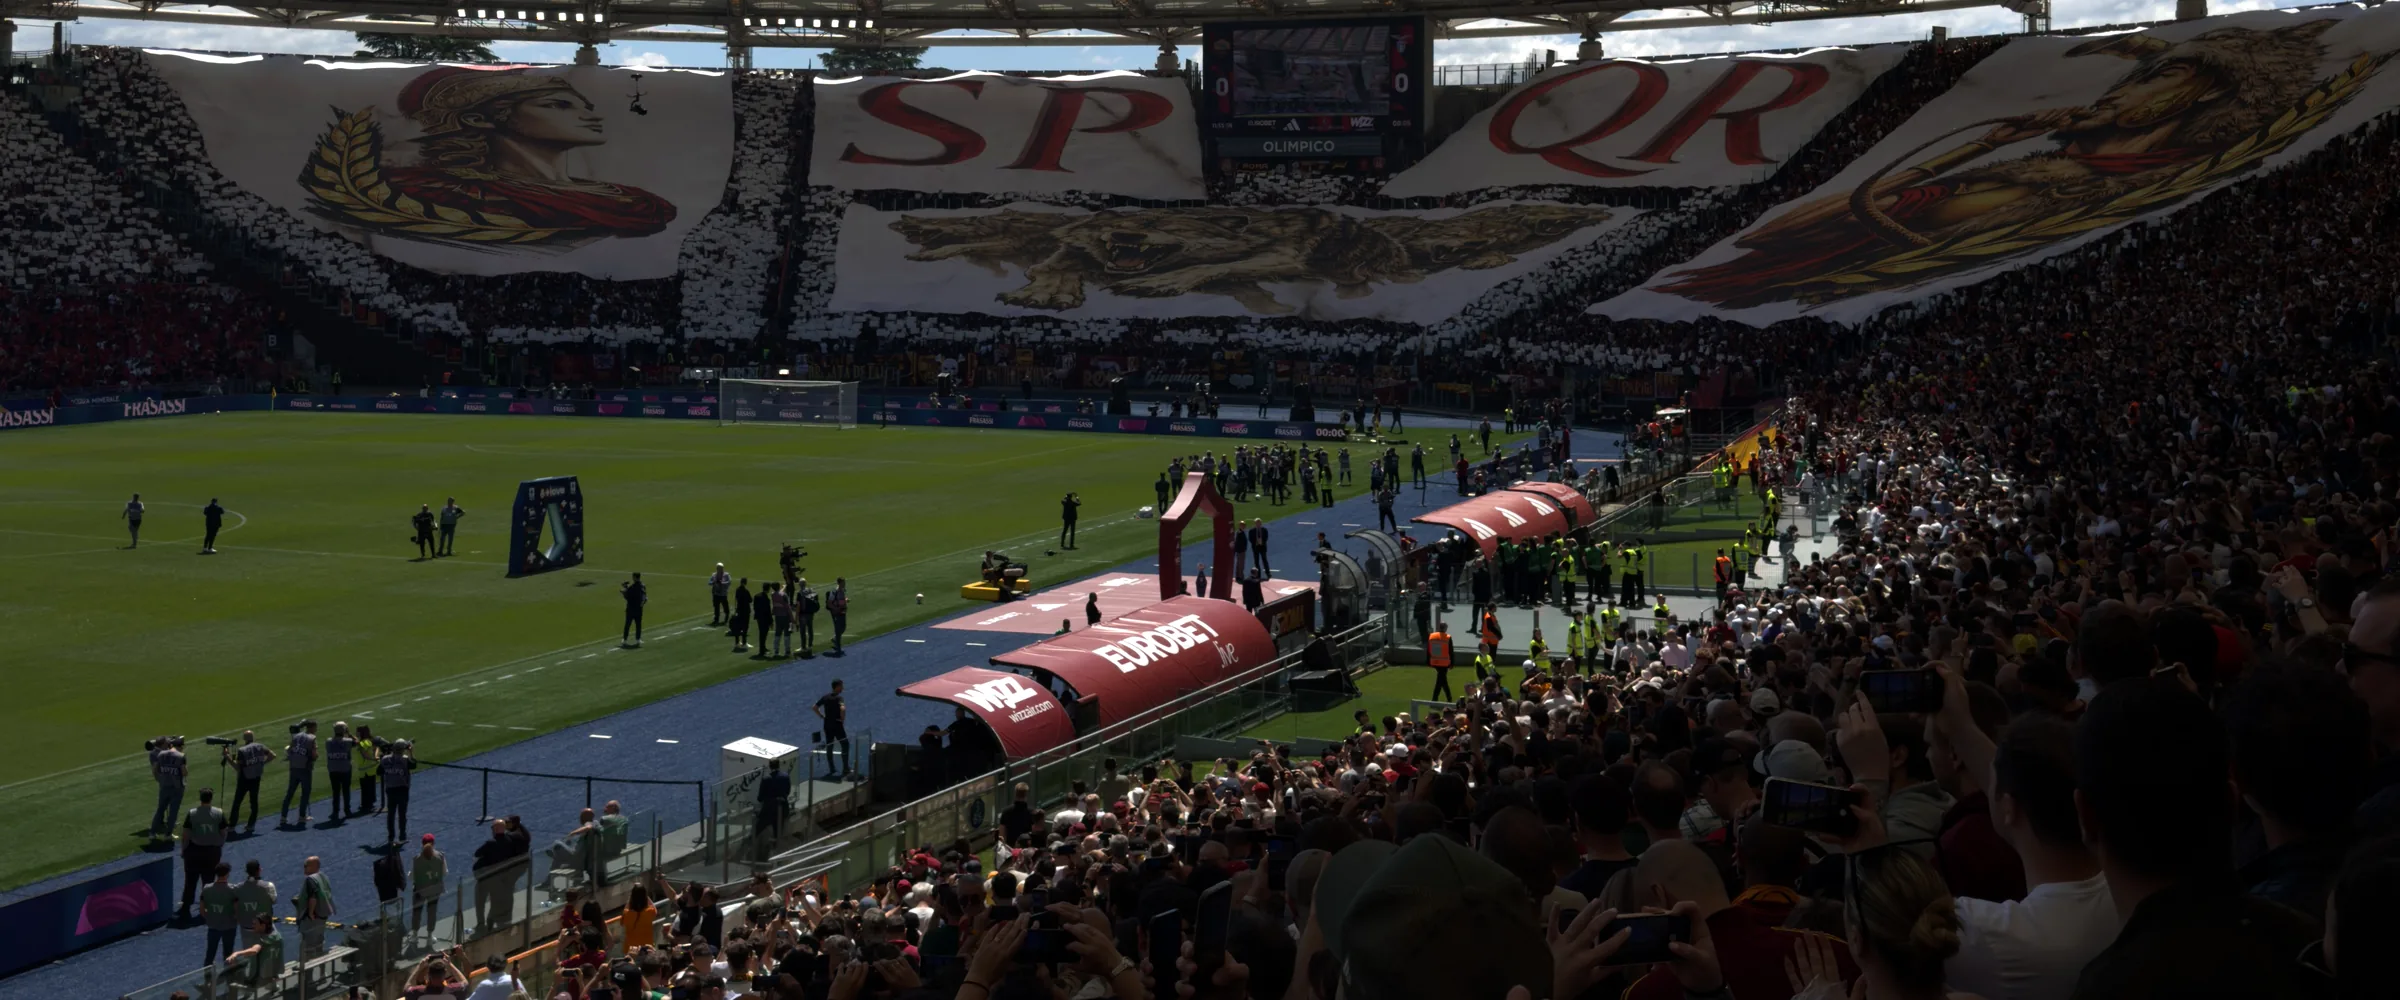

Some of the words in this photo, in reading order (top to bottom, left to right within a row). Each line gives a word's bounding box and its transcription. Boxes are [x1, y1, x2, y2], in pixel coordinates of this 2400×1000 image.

[1215, 77, 1229, 97] 0
[1394, 73, 1409, 93] 0
[1263, 140, 1335, 153] OLIMPICO
[124, 399, 185, 417] FRASASSI
[1316, 428, 1344, 437] 00:00
[1092, 613, 1218, 674] EUROBET
[1008, 700, 1054, 723] wizzair.com
[210, 903, 224, 914] TV
[243, 901, 258, 912] TV
